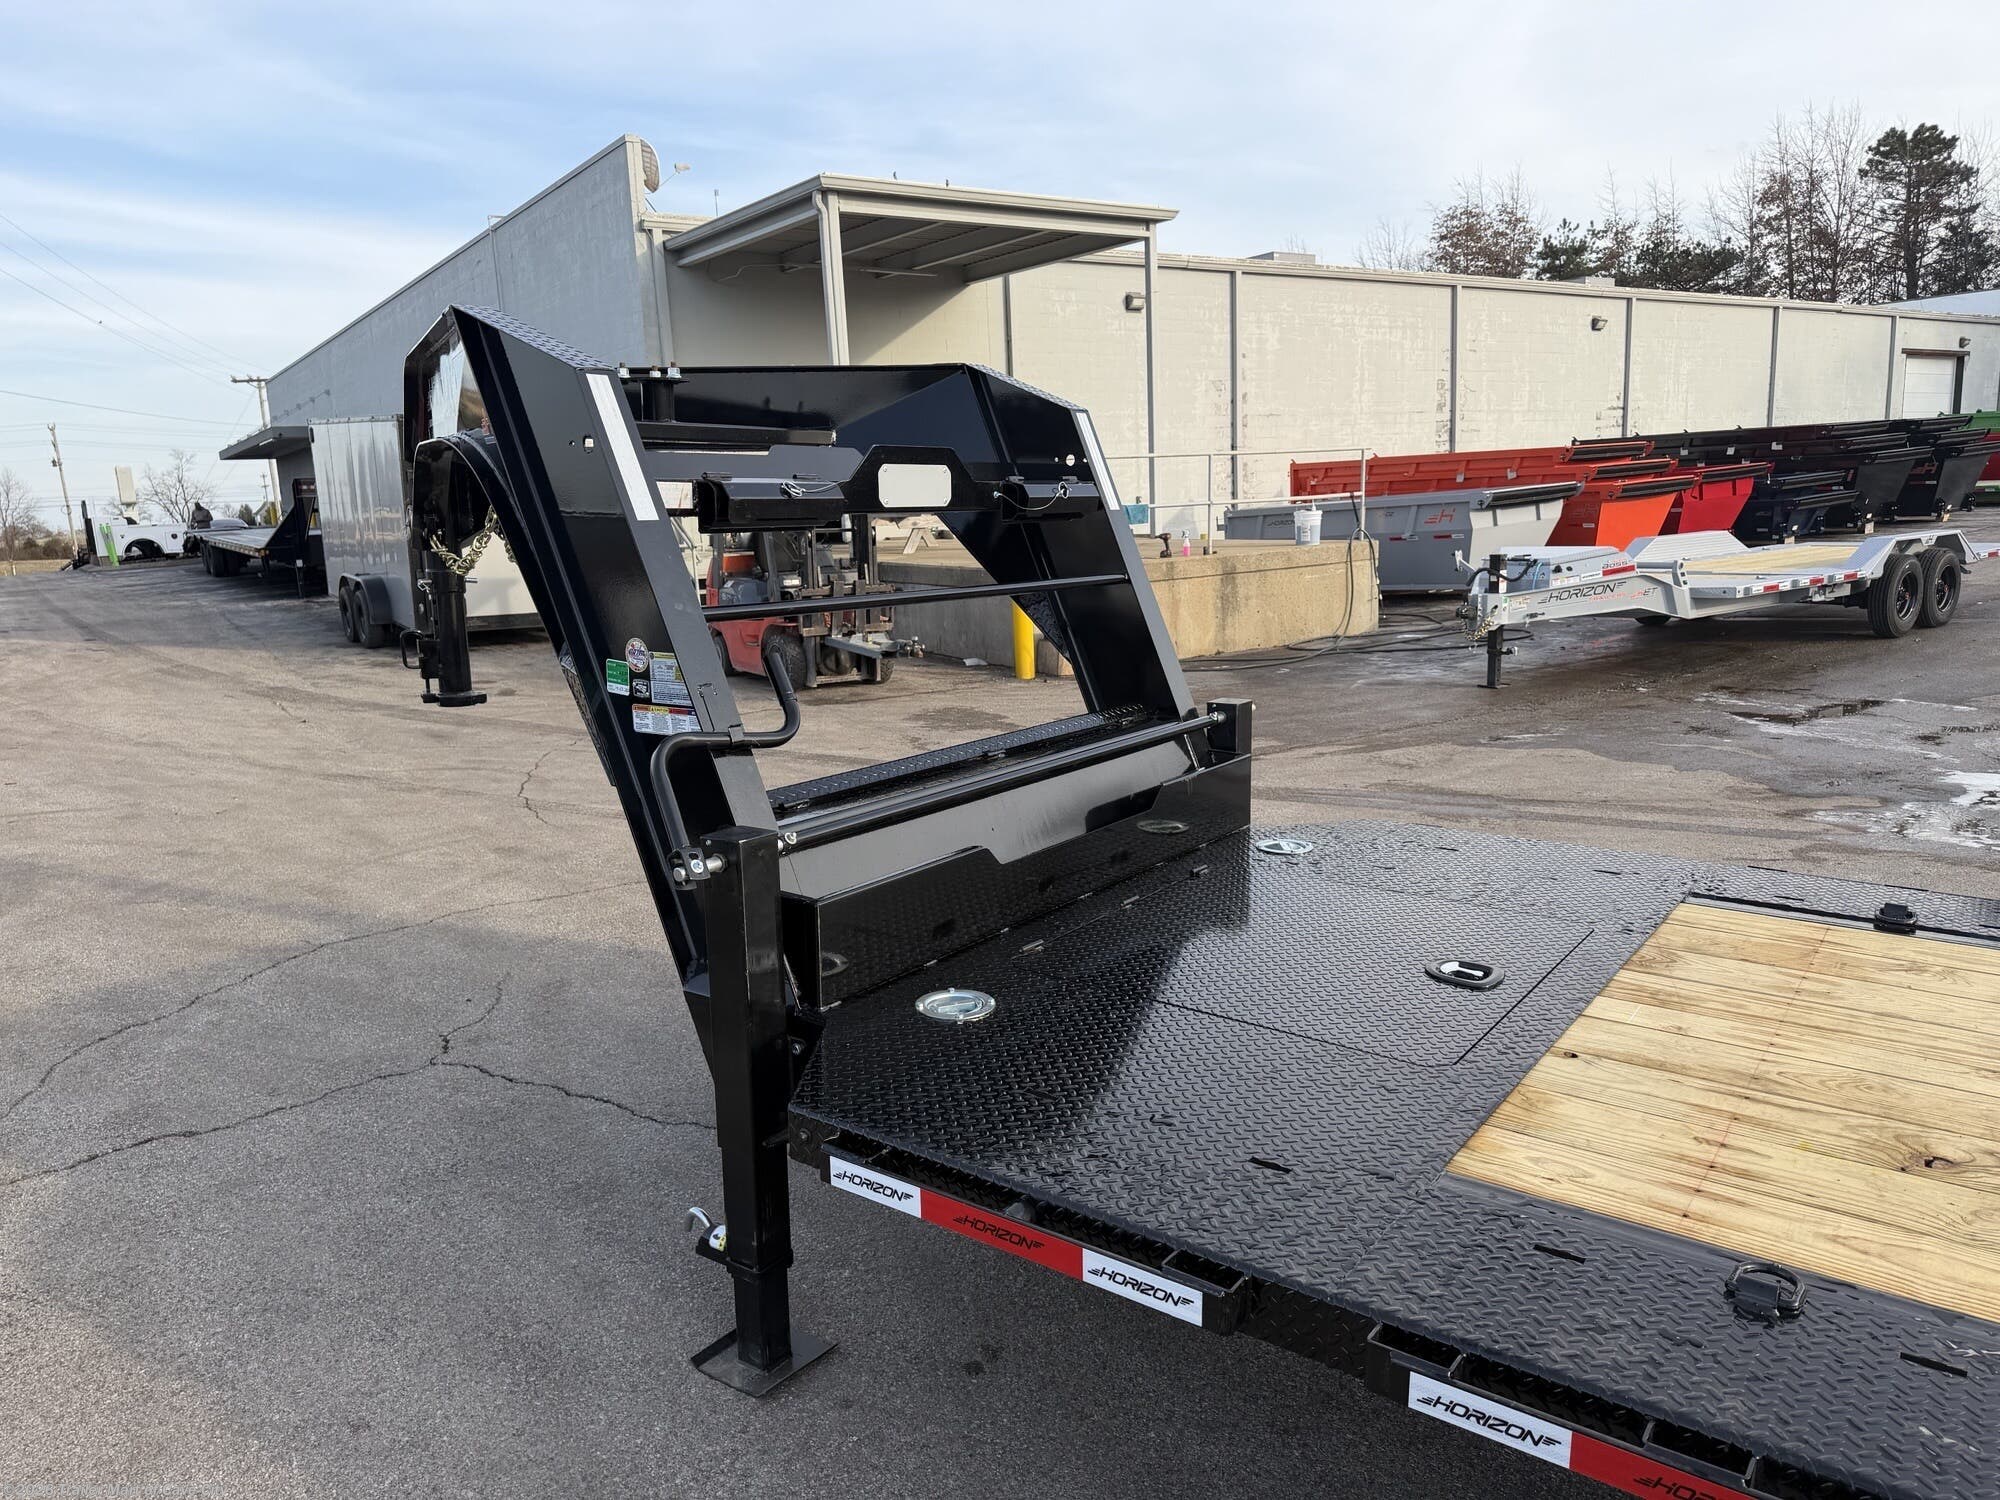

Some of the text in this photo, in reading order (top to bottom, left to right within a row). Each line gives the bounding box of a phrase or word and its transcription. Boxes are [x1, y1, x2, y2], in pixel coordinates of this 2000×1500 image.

[1548, 583, 1617, 602] HORIZON
[841, 1171, 904, 1202] HORIZON
[962, 1215, 1035, 1250] HORIZON
[1099, 1266, 1183, 1308] HORIZON
[1433, 1396, 1544, 1447] HORIZON
